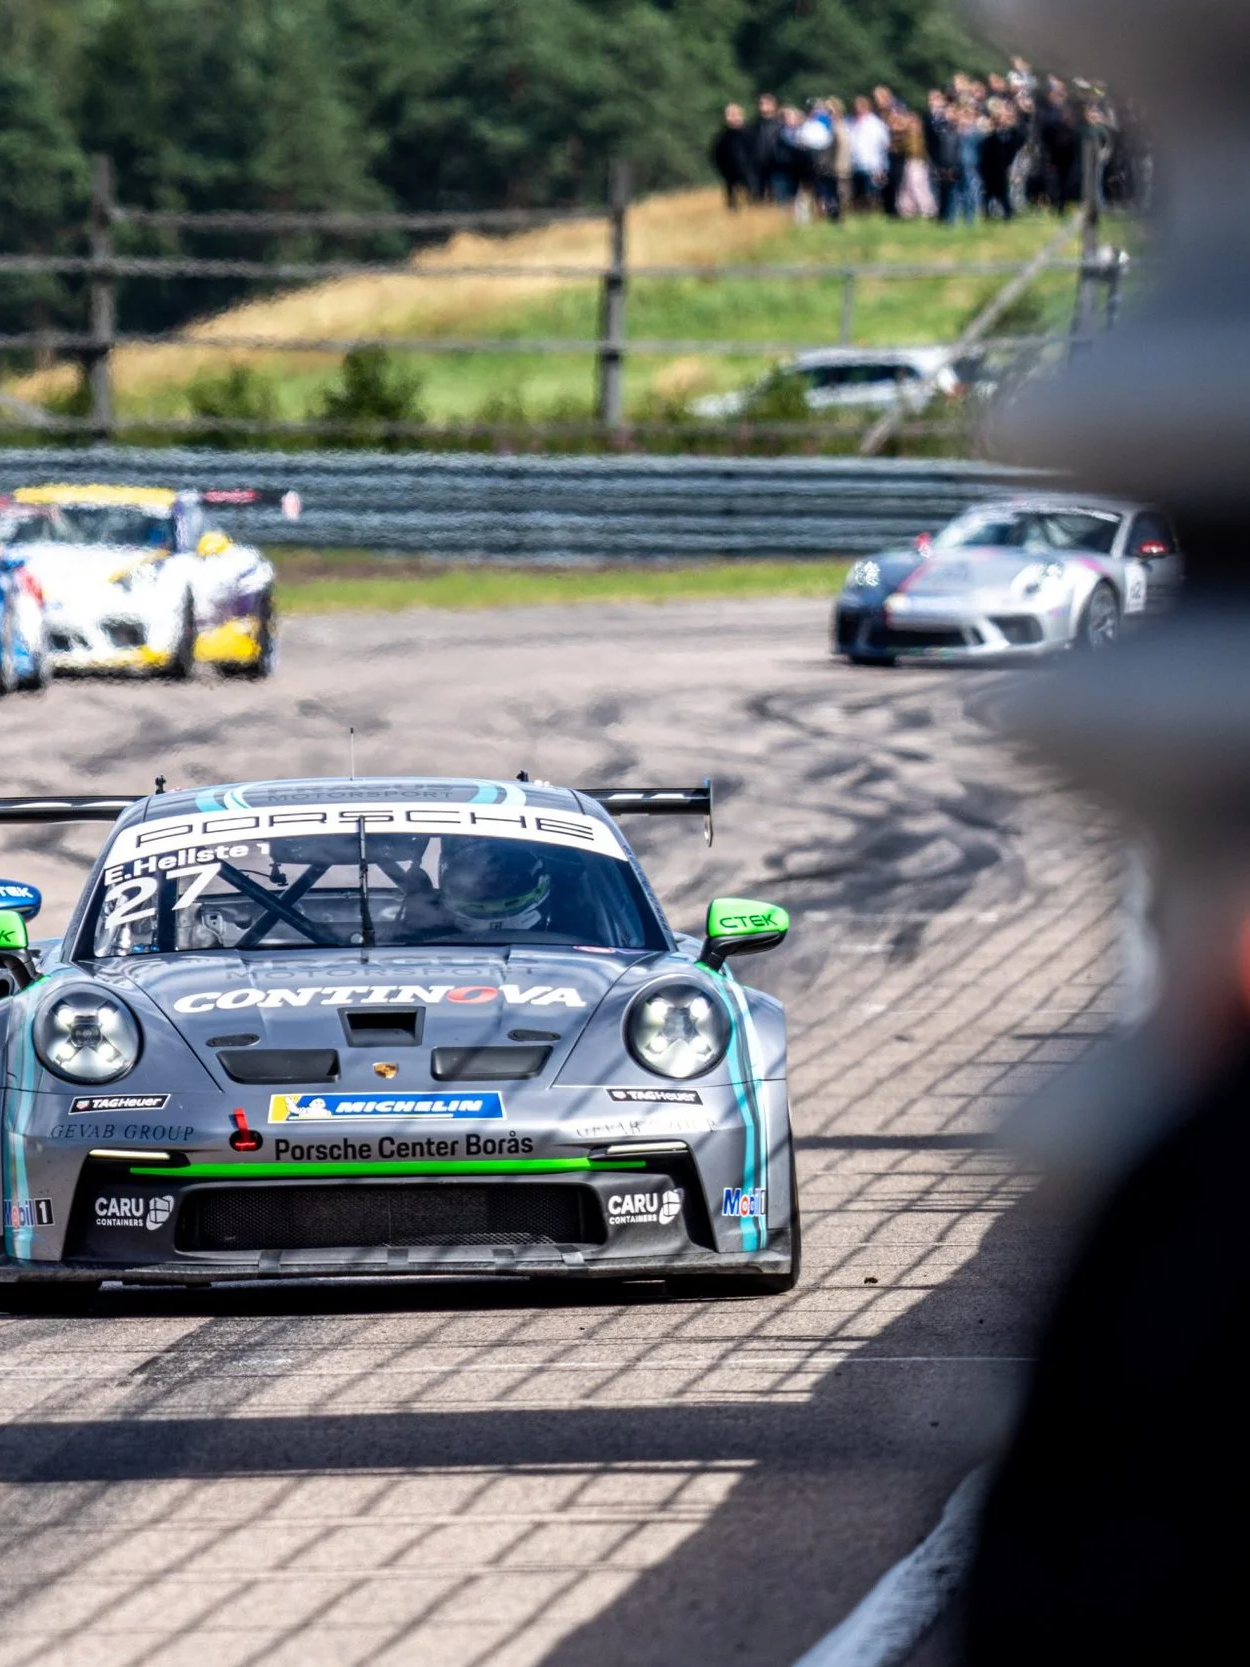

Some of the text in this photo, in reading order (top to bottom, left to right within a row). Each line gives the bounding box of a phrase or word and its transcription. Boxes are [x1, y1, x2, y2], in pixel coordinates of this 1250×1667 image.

[267, 791, 454, 802] MOTORSPORT
[135, 809, 595, 848] PORSCHE
[104, 862, 223, 931] 27
[719, 913, 778, 929] CTEK
[226, 965, 541, 980] MOTORSPORT
[173, 984, 588, 1014] CONTINOVA
[334, 1099, 484, 1113] MICHELIN
[50, 1123, 196, 1142] GEVAB GROUP
[274, 1130, 535, 1161] Porsche Center Borås
[94, 1197, 145, 1217] CARU
[607, 1192, 658, 1215] CARU
[95, 1218, 144, 1227] CONTAINERS
[608, 1214, 658, 1225] CONTAINERS
